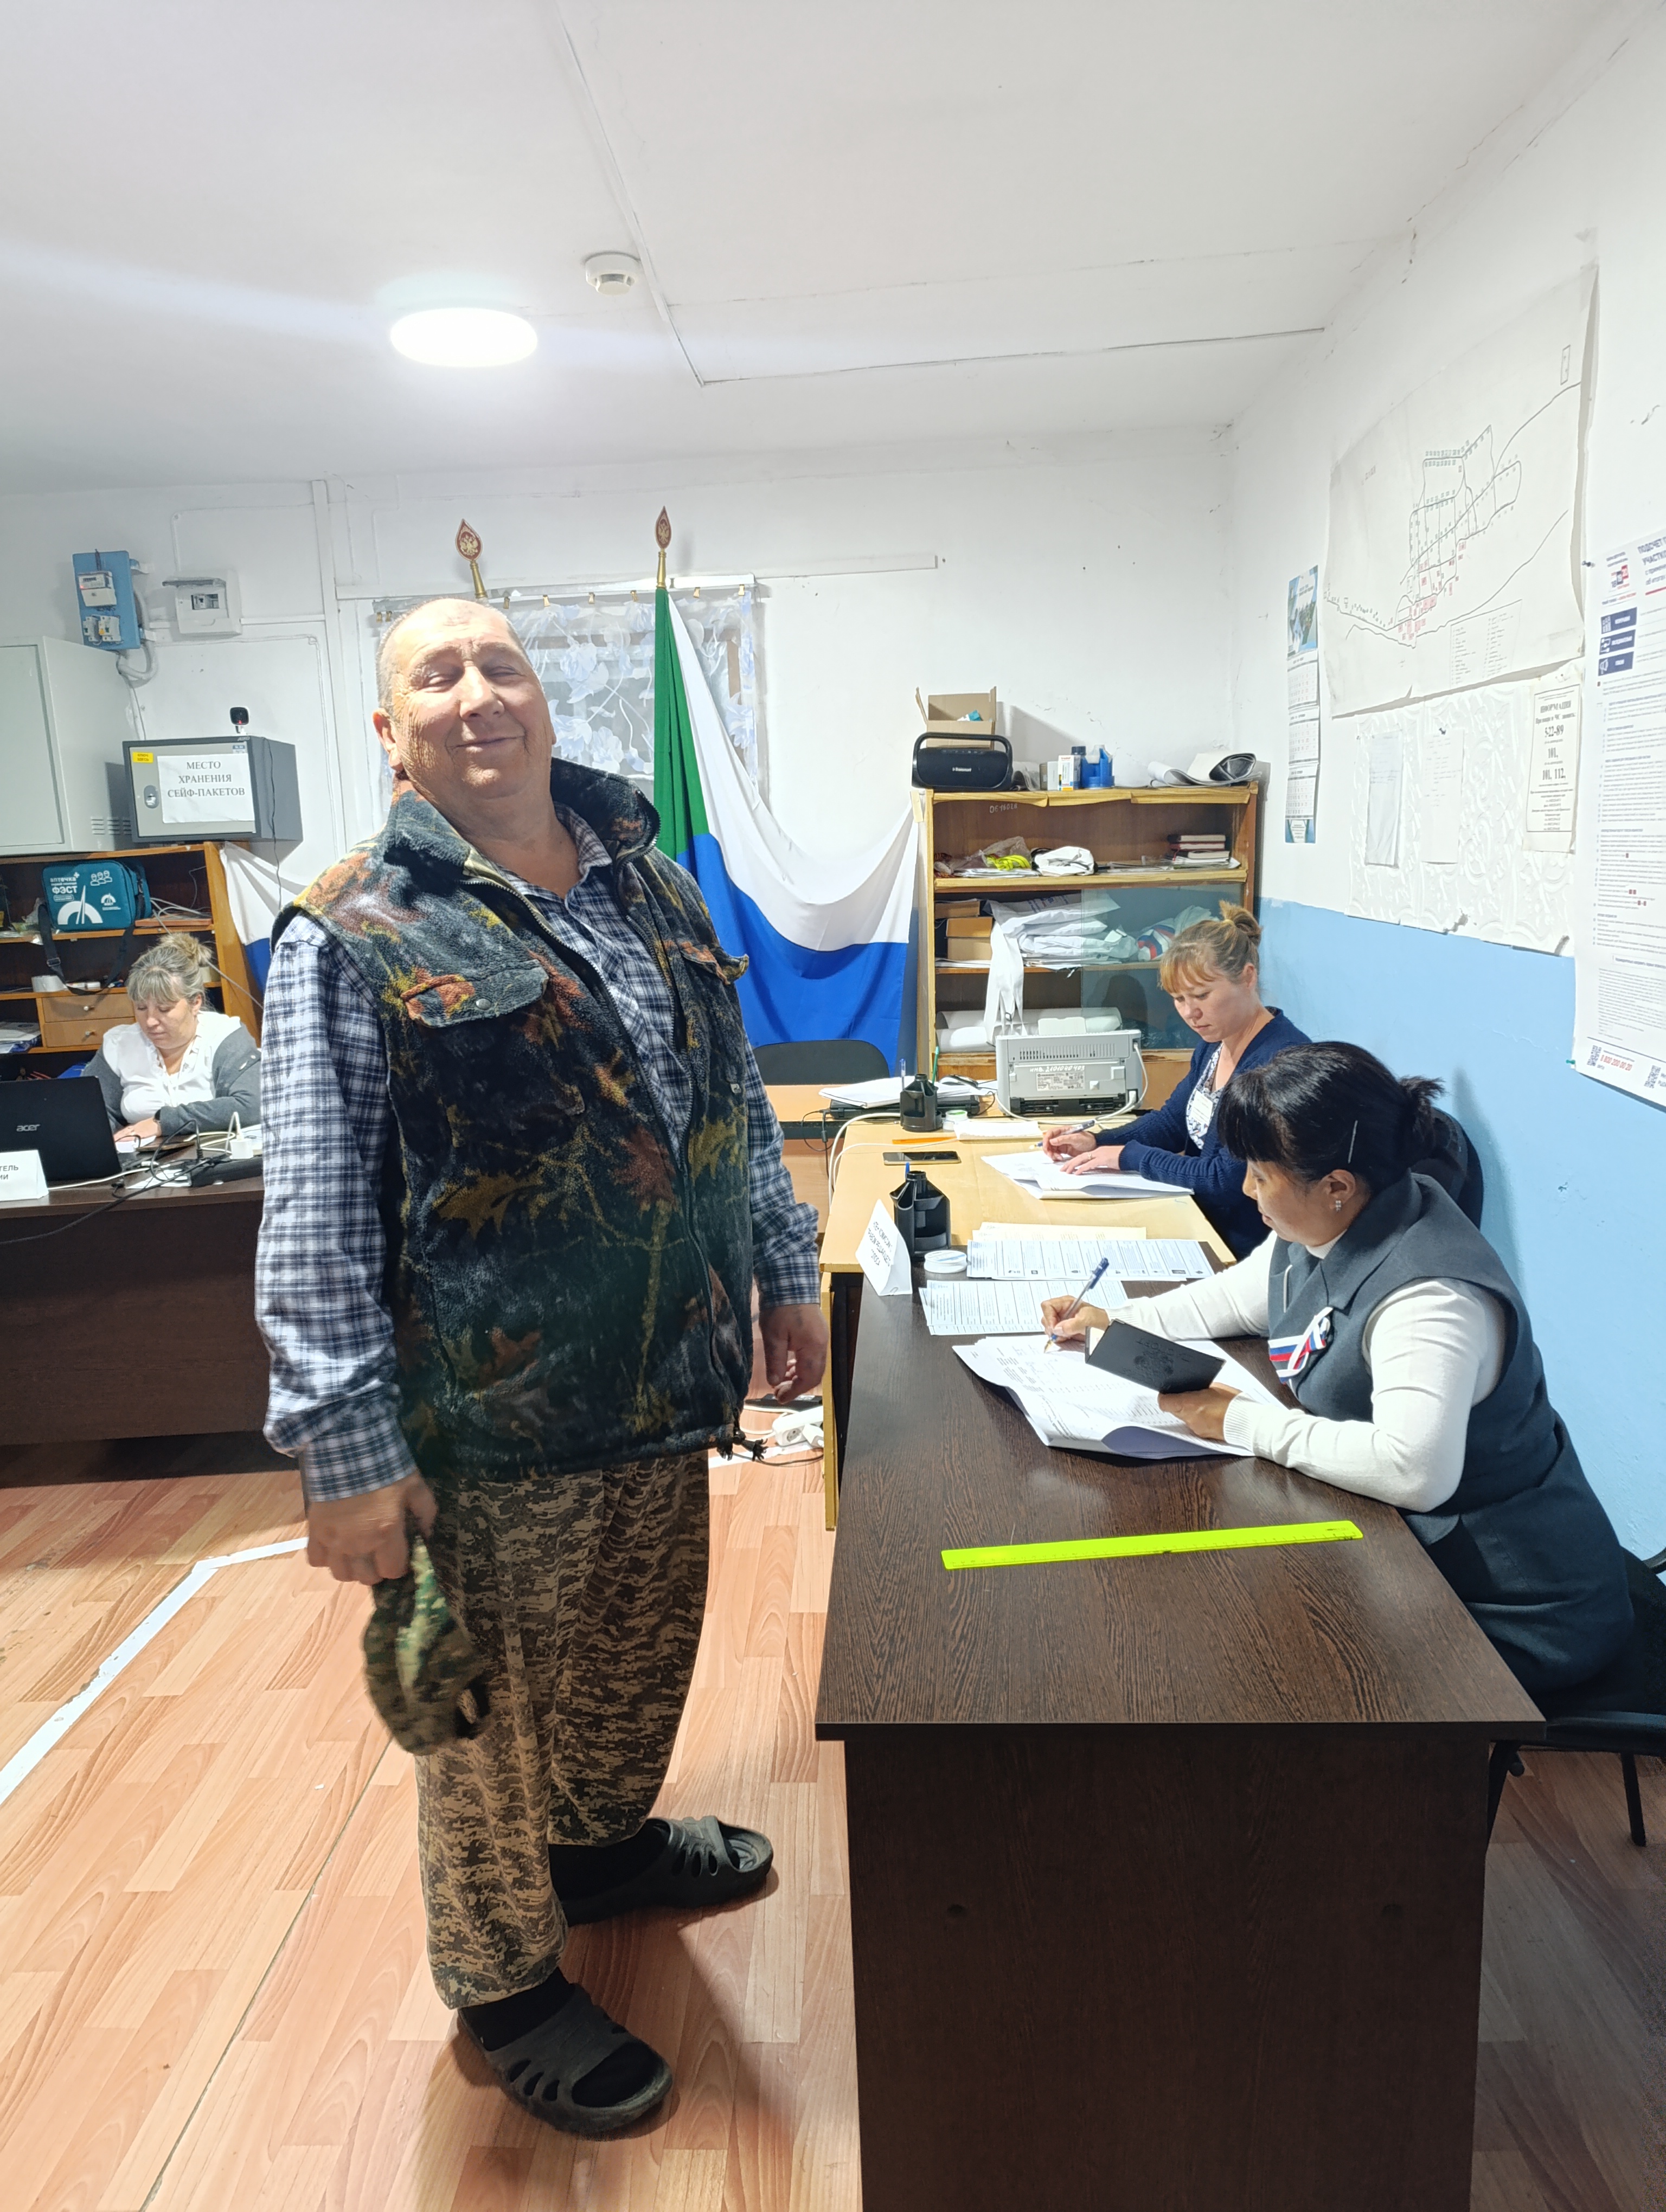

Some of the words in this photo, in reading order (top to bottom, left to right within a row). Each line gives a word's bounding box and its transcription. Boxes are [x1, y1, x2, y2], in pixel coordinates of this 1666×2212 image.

[186, 761, 221, 770] МЕСТО
[178, 774, 232, 784] ХРАНЕНИЯ
[167, 787, 246, 798] СЕЙФ-ПАКЕТОВ
[52, 886, 78, 895] ФЭСТ
[16, 1124, 41, 1132] acer
